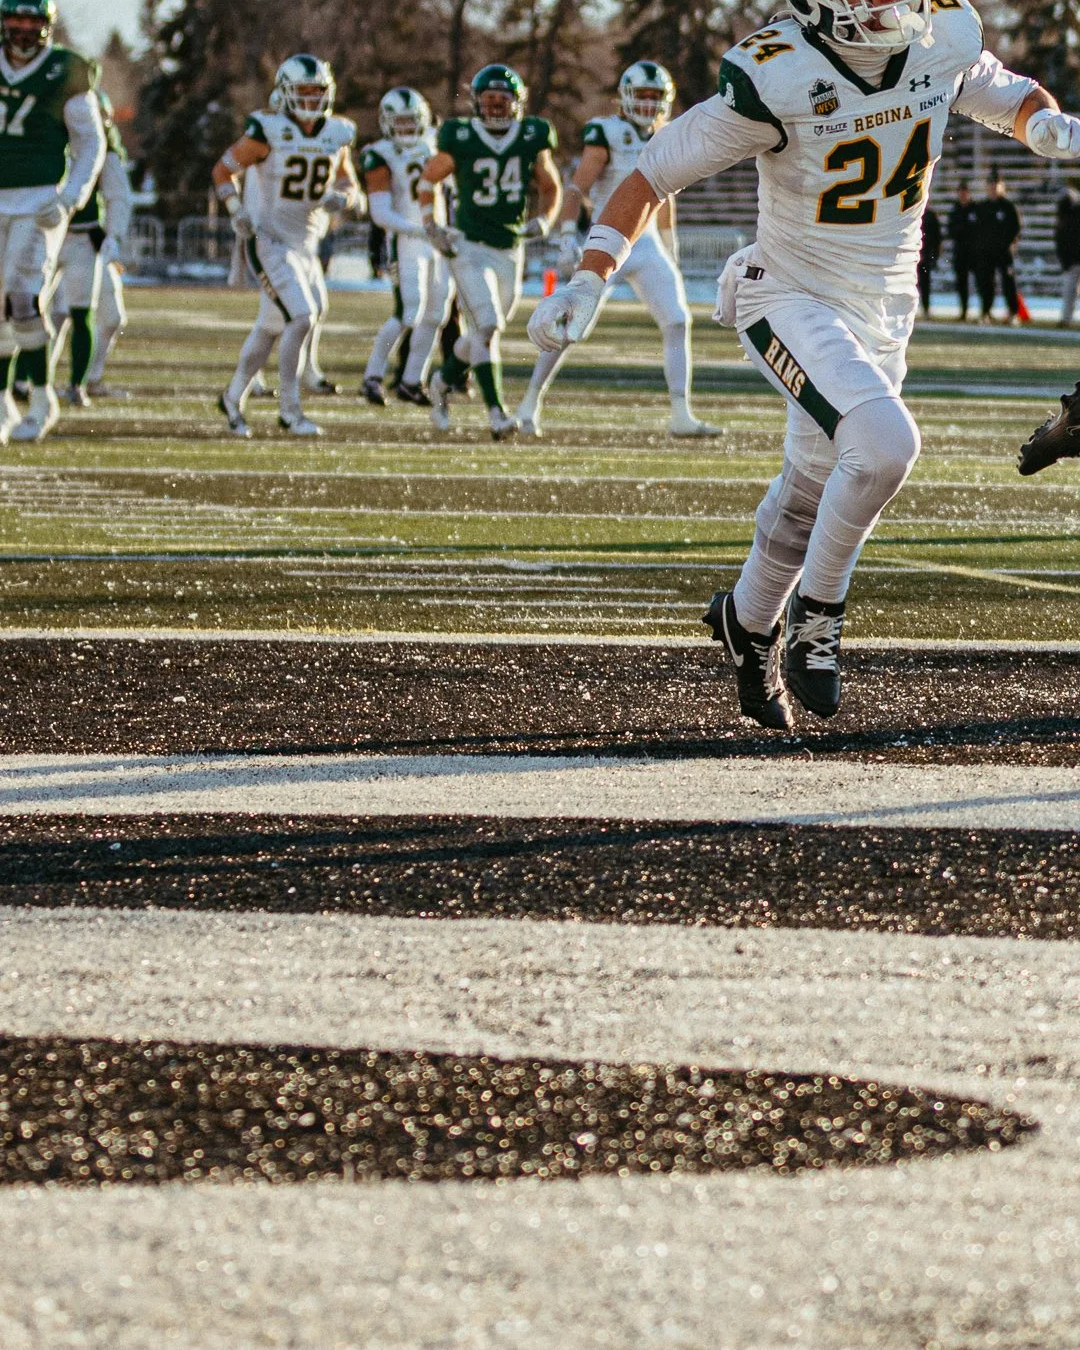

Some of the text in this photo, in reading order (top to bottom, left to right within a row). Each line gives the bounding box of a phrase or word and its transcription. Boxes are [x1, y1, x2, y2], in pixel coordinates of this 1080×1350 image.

[739, 29, 796, 65] 24
[813, 91, 835, 105] CANADA
[815, 98, 838, 115] WEST
[825, 122, 848, 132] ELITE
[854, 105, 913, 133] REGINA
[281, 154, 332, 202] 28
[472, 155, 523, 207] 34
[815, 117, 932, 225] 24
[764, 336, 806, 398] RAMS
